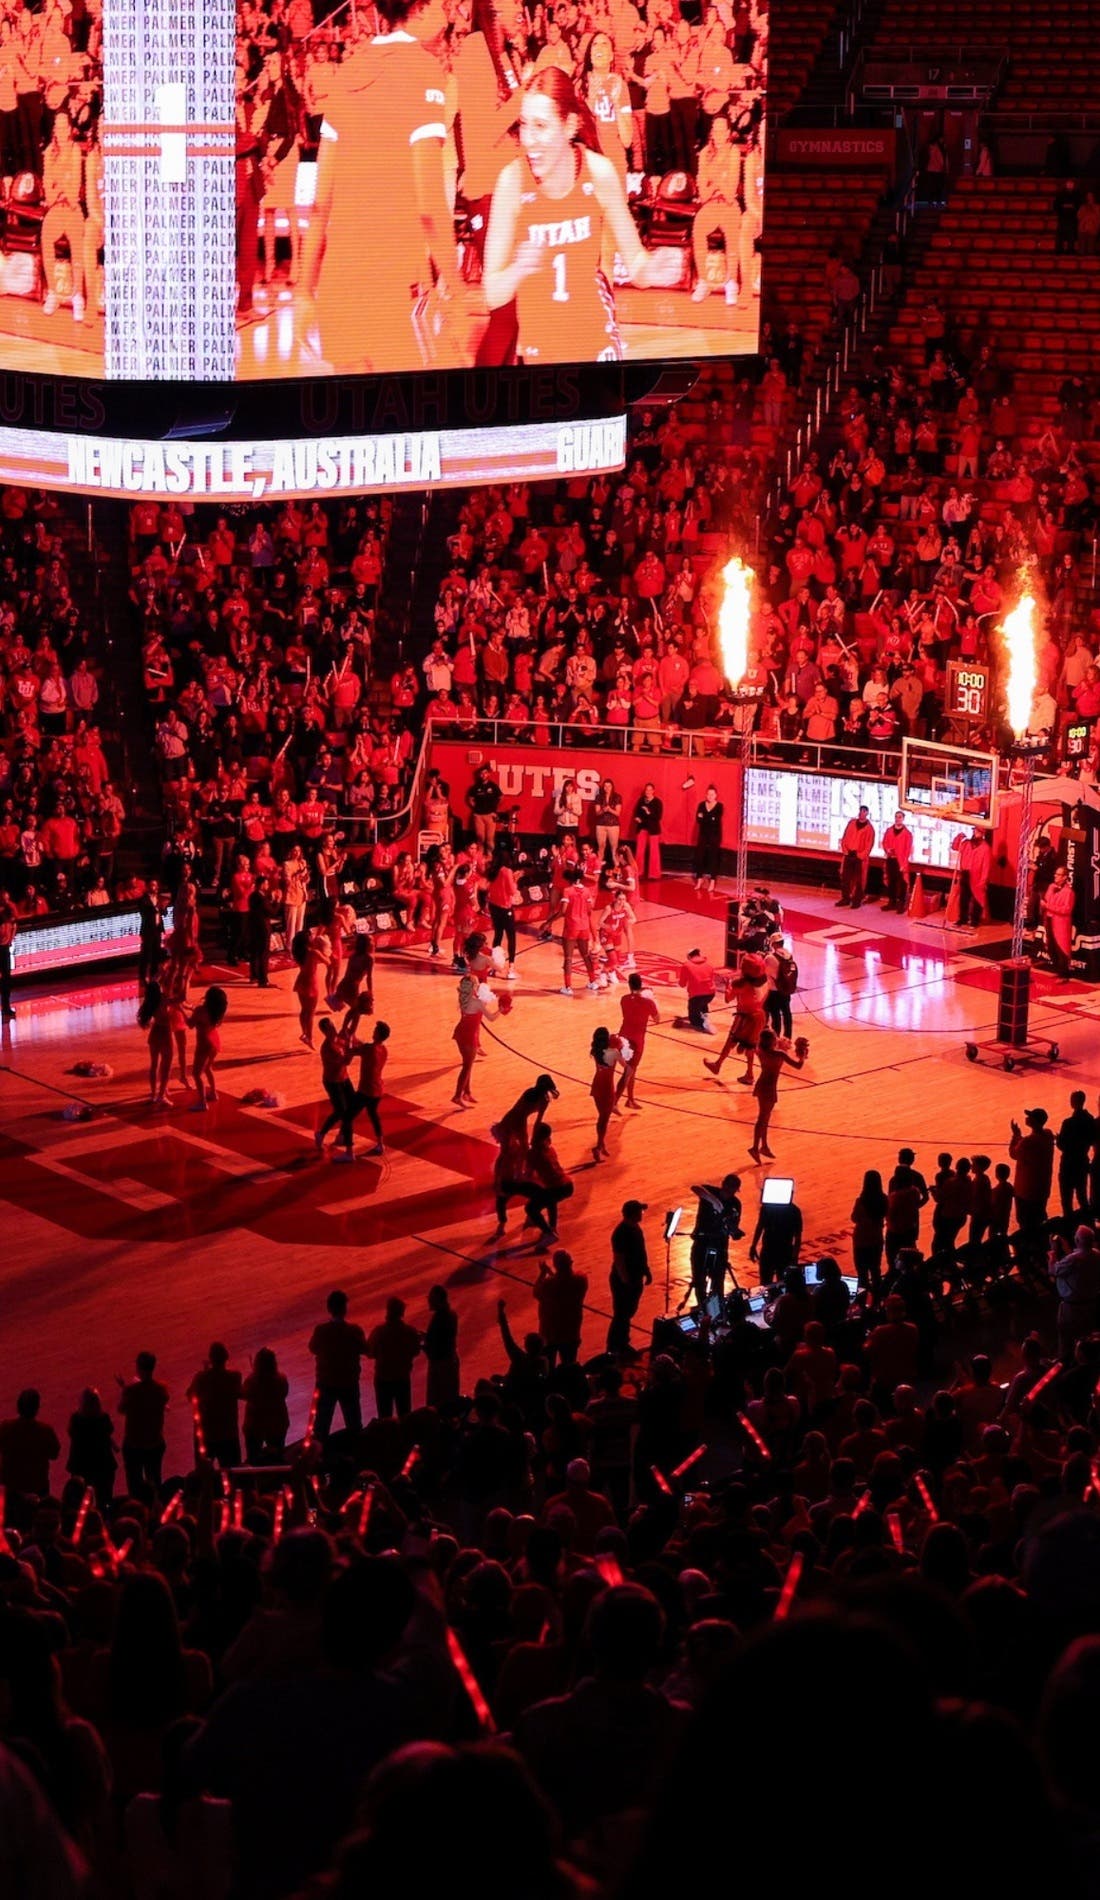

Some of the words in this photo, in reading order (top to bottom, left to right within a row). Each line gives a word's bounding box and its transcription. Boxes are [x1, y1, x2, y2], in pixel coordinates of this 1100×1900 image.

[144, 16, 195, 29] PALMER
[144, 34, 195, 48] PALMER
[144, 52, 195, 66] PALMER
[144, 71, 195, 84] PALMER
[928, 68, 940, 81] 17
[789, 140, 885, 152] GYMNASTICS
[145, 197, 195, 210] PALMER
[145, 215, 195, 228] PALMER
[528, 215, 592, 247] UTAH
[145, 233, 195, 246] PALMER
[145, 250, 195, 264] PALMER
[145, 268, 195, 282] PALMER
[551, 253, 570, 302] 1
[145, 286, 195, 299] PALMER
[300, 374, 448, 432] UTAH
[462, 367, 582, 422] UTES
[68, 438, 266, 497] NEWCASTLE,
[271, 431, 441, 491] AUSTRALIA
[958, 671, 984, 689] 10:00
[957, 687, 980, 714] 30
